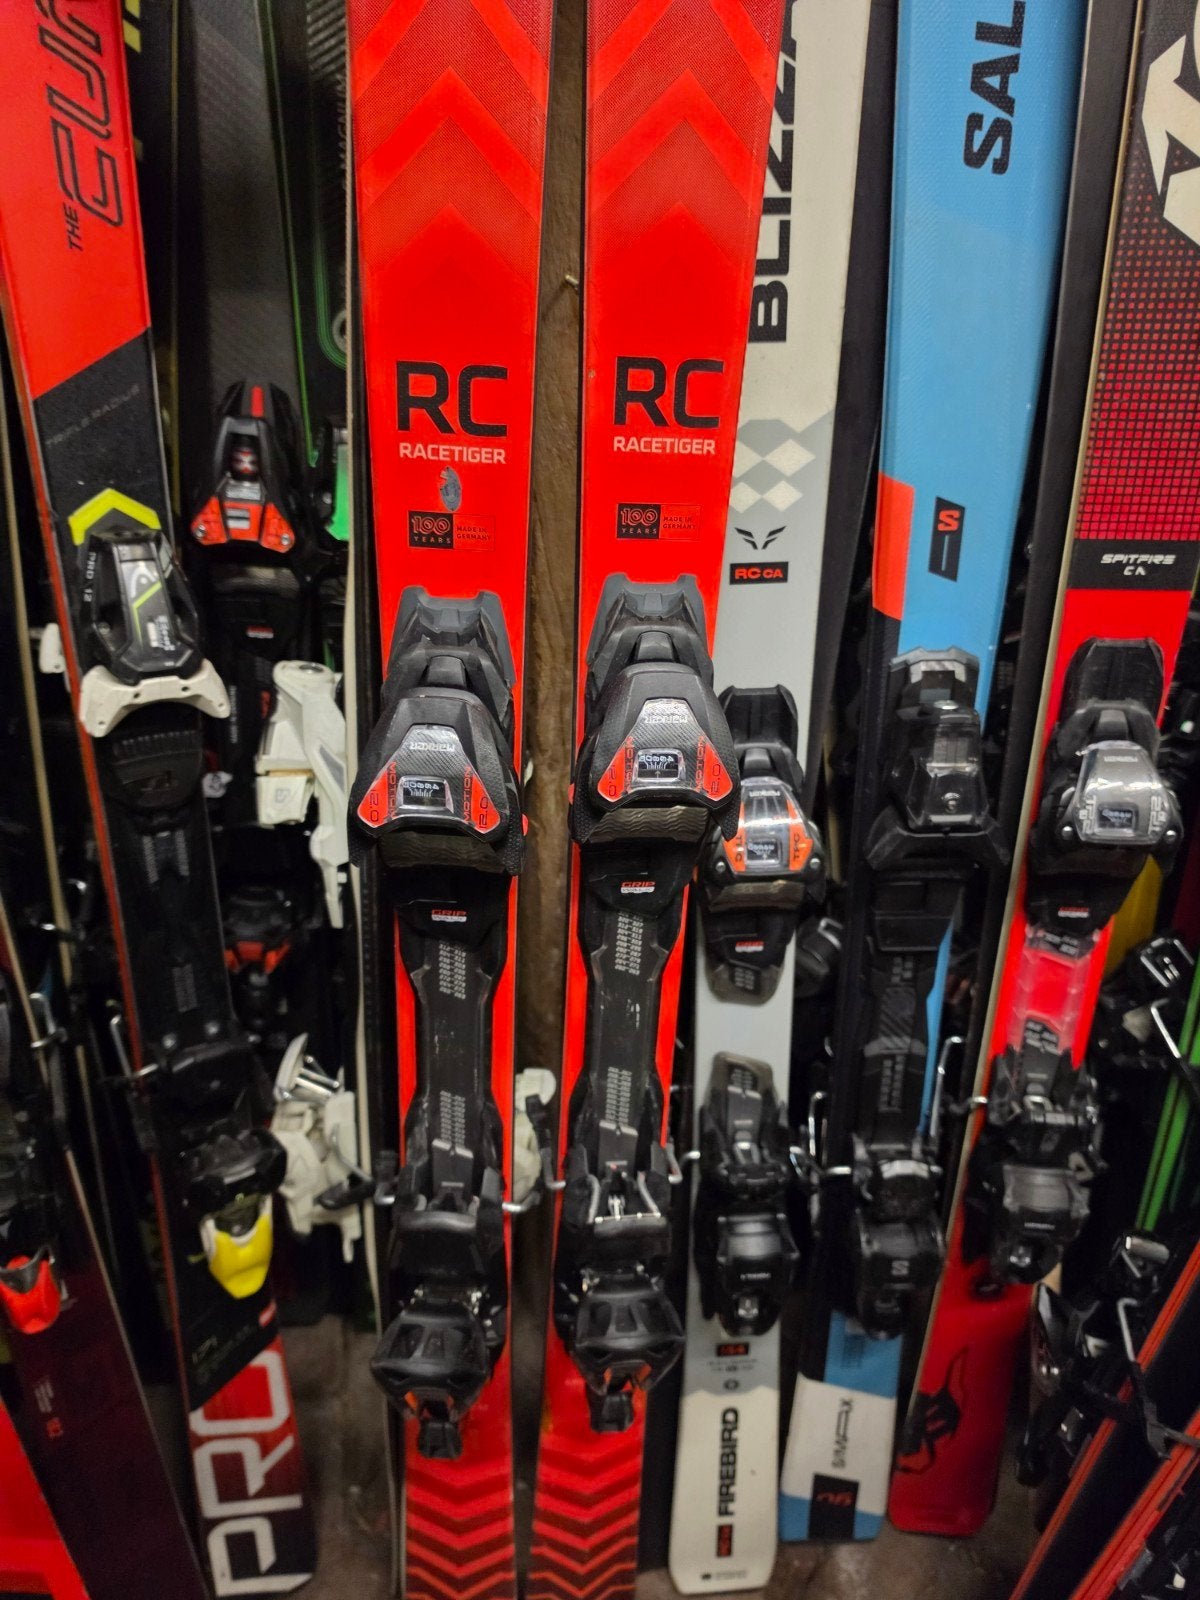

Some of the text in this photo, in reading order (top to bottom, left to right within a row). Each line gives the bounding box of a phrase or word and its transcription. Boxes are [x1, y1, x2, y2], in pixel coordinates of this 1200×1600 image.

[963, 0, 1026, 175] SAL
[63, 202, 84, 251] THE
[396, 360, 508, 437] RC
[613, 356, 724, 429] RC
[399, 442, 506, 465] RACETIGER
[613, 435, 716, 455] RACETIGER
[411, 516, 451, 536] 100
[620, 506, 658, 527] 100
[662, 522, 697, 530] GERMANY
[413, 536, 452, 544] YEARS
[621, 527, 658, 535] YEARS
[1100, 553, 1176, 566] SPITFIRE
[734, 567, 784, 580] RC CA
[1123, 566, 1146, 576] CA
[717, 1406, 740, 1518] FIREBIRD
[189, 1350, 313, 1597] PRO
